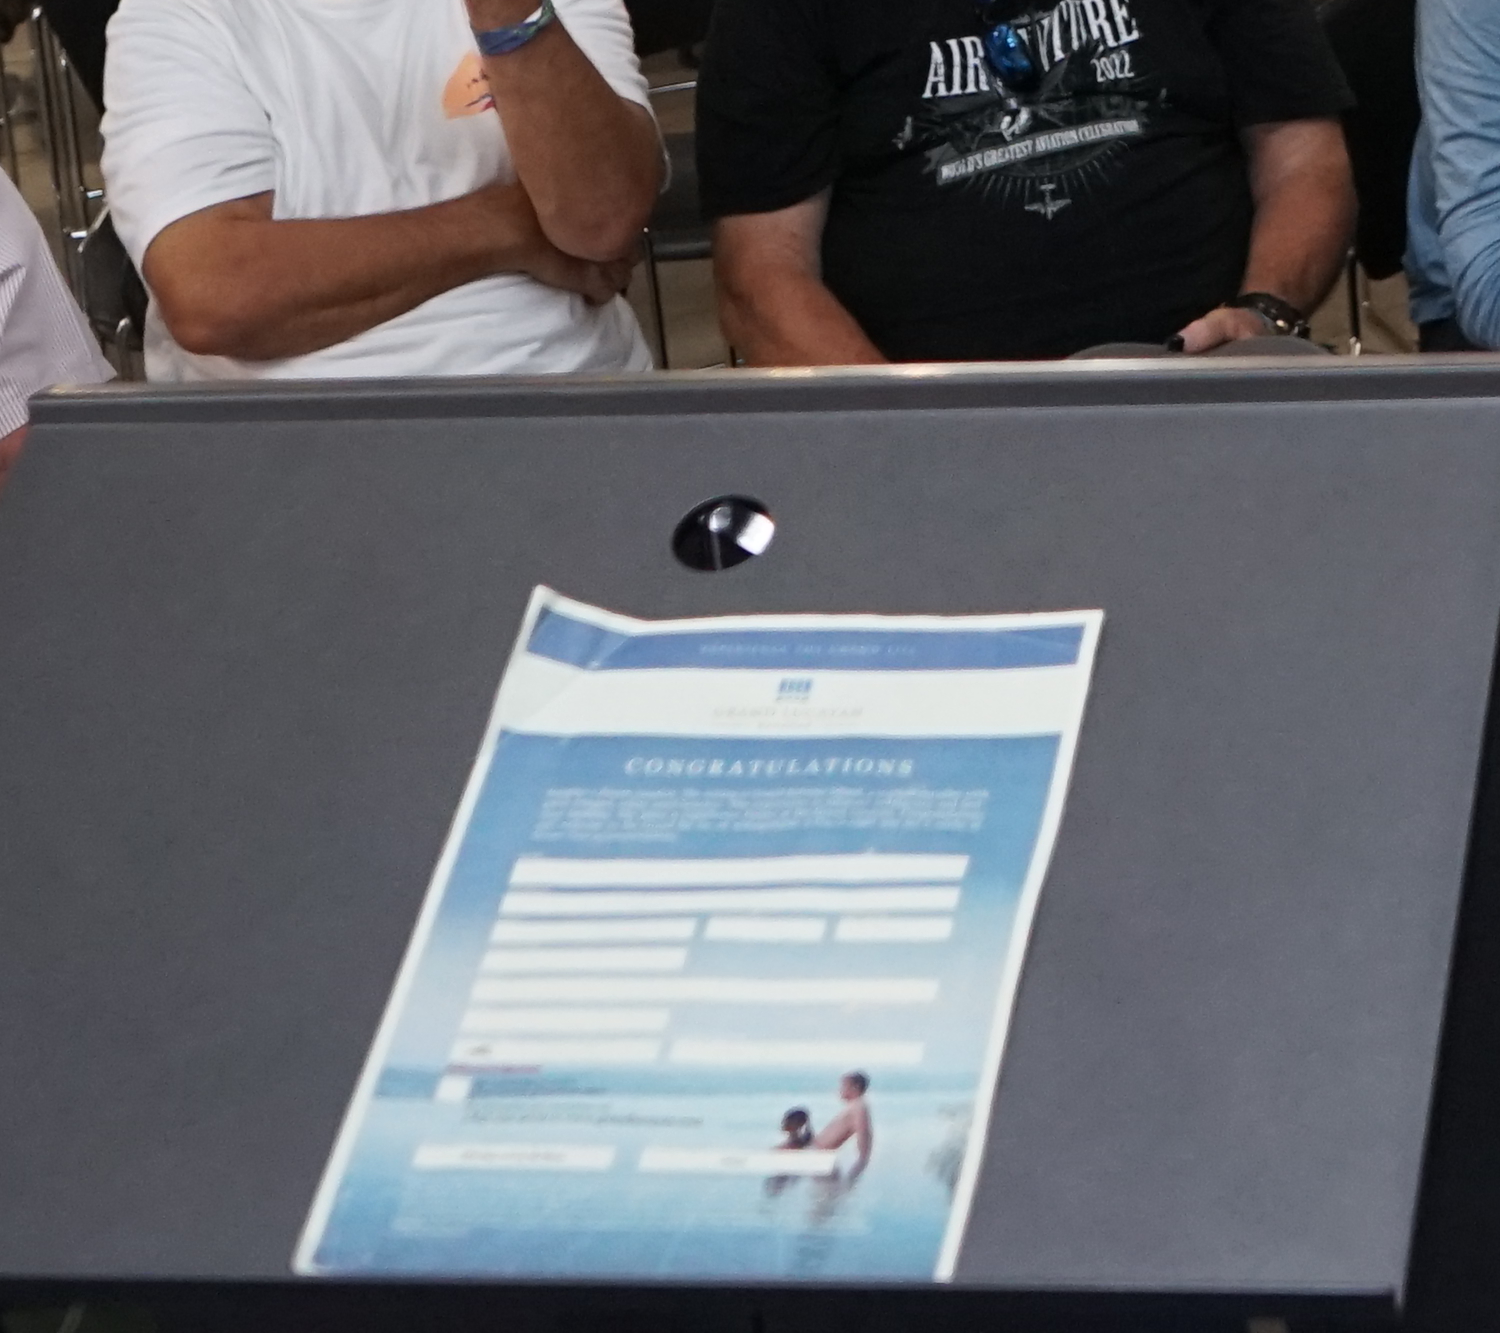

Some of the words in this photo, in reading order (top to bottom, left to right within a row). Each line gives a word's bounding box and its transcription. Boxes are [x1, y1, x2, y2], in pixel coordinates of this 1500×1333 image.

[1091, 49, 1135, 83] 2022
[984, 139, 1033, 167] GREATEST
[1035, 130, 1077, 153] AVIATION
[1078, 119, 1140, 141] CELEBRATION
[623, 755, 915, 777] CONGRATULATIONS
